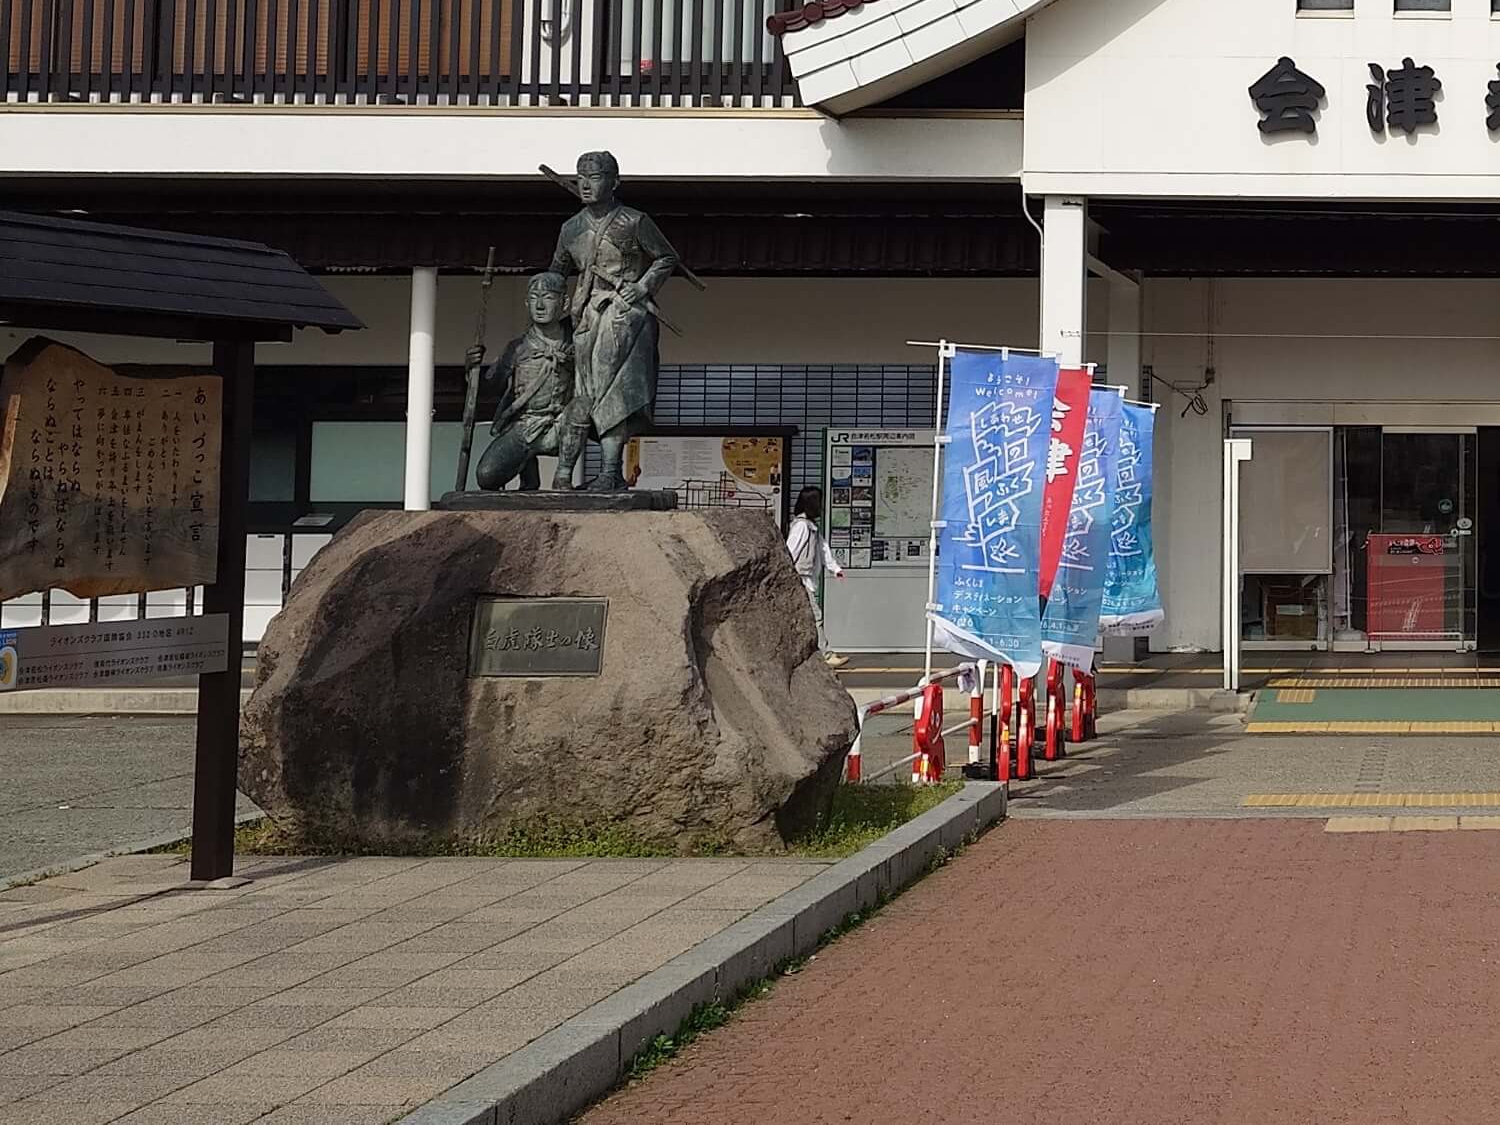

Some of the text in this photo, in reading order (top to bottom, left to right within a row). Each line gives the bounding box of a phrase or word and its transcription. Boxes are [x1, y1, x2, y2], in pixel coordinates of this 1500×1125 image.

[975, 386, 1038, 400] Welcome!
[43, 378, 57, 480] ならぬことは
[981, 414, 1024, 428] しあわせ
[70, 378, 86, 492] やってはならぬ
[831, 432, 850, 443] JR
[1009, 446, 1020, 458] の
[190, 386, 207, 543] あいづっこ宣言
[25, 428, 42, 553] ならぬものです
[974, 469, 993, 494] 風
[996, 475, 1019, 495] ふく
[54, 442, 70, 569] やらねばならぬ
[986, 508, 1009, 527] しま
